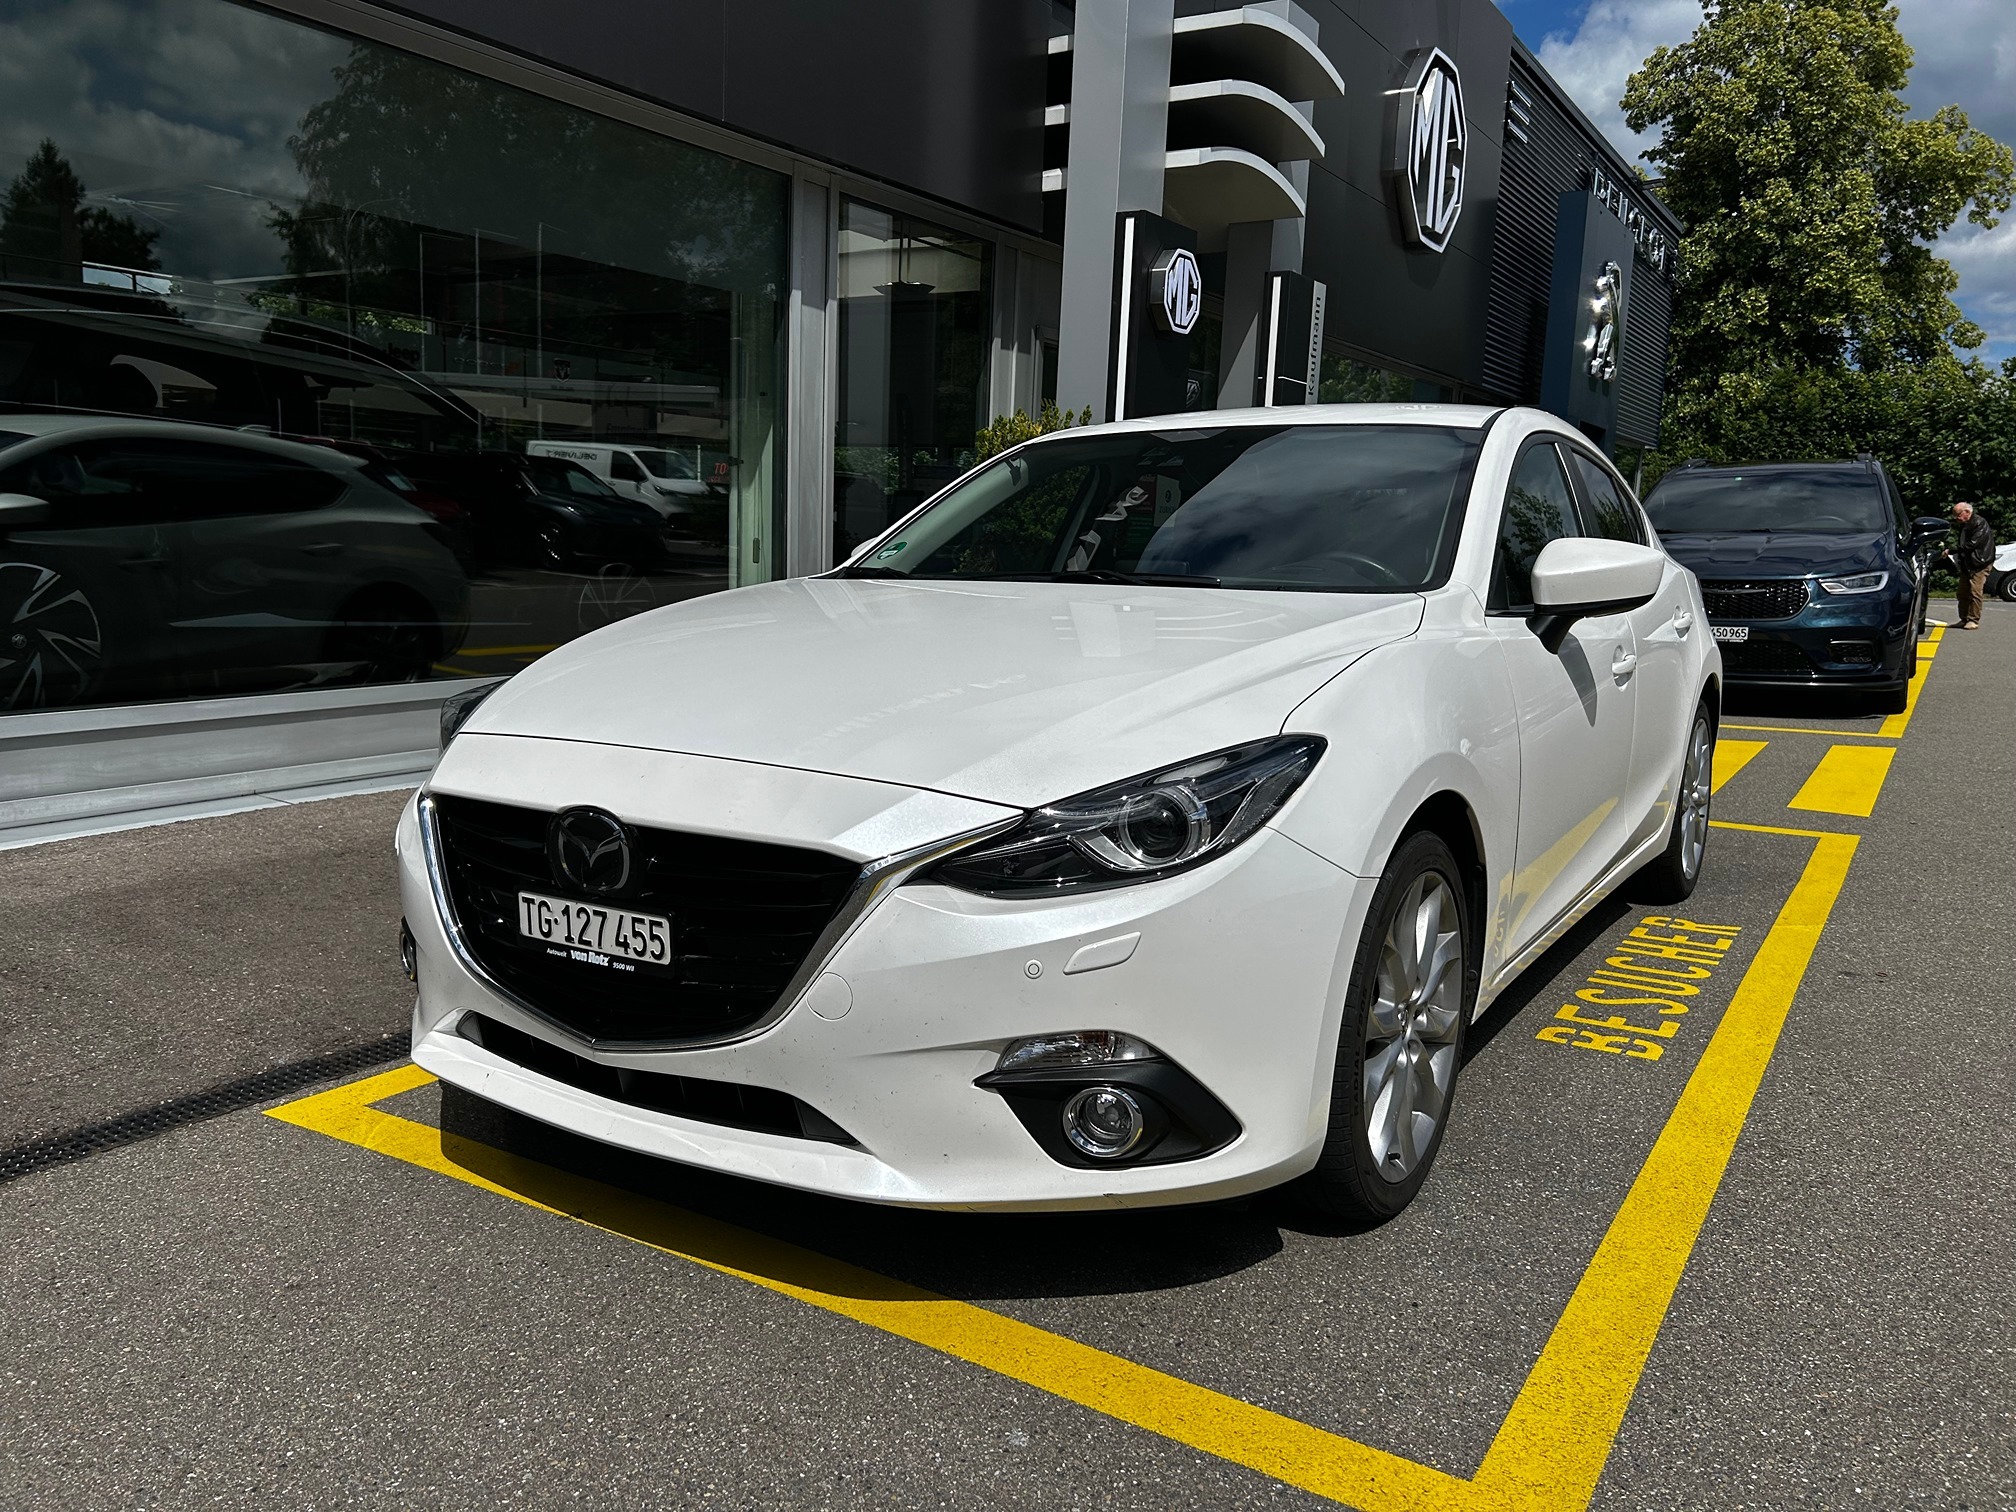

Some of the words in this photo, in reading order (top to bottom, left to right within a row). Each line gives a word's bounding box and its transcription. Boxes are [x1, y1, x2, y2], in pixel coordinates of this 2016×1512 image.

[1412, 64, 1463, 236] MG
[1166, 256, 1199, 328] MG
[1307, 296, 1321, 396] Kaufmann
[570, 949, 587, 962] von
[588, 951, 610, 967] Rotz
[612, 961, 626, 970] 9500
[1535, 915, 1742, 1061] BESUCHER
